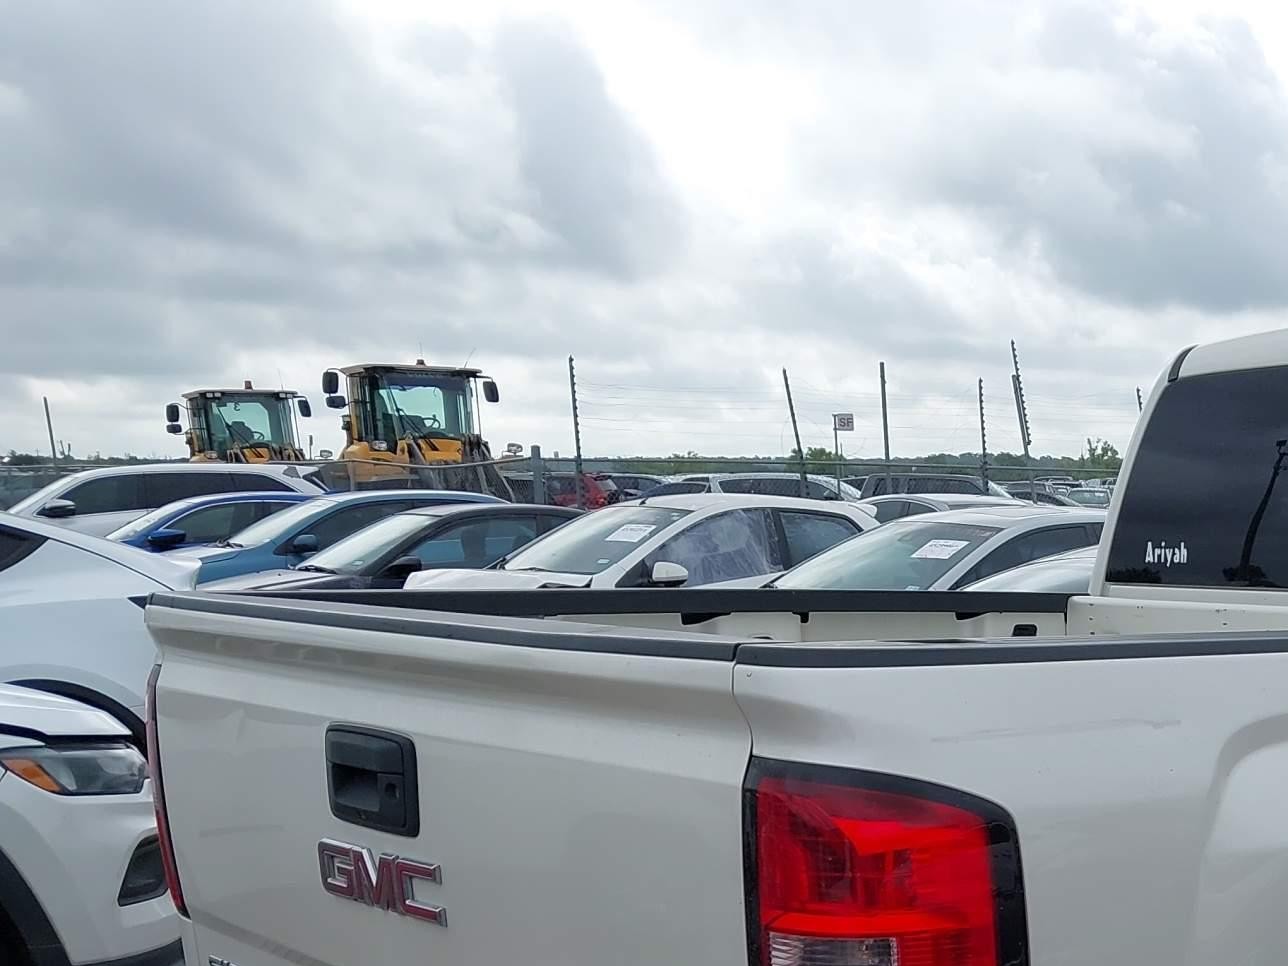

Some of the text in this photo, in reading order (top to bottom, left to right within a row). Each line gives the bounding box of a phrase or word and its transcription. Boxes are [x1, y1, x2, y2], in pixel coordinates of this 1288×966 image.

[839, 417, 854, 428] SF
[1144, 540, 1188, 568] Ariyah
[317, 838, 448, 928] GMC
